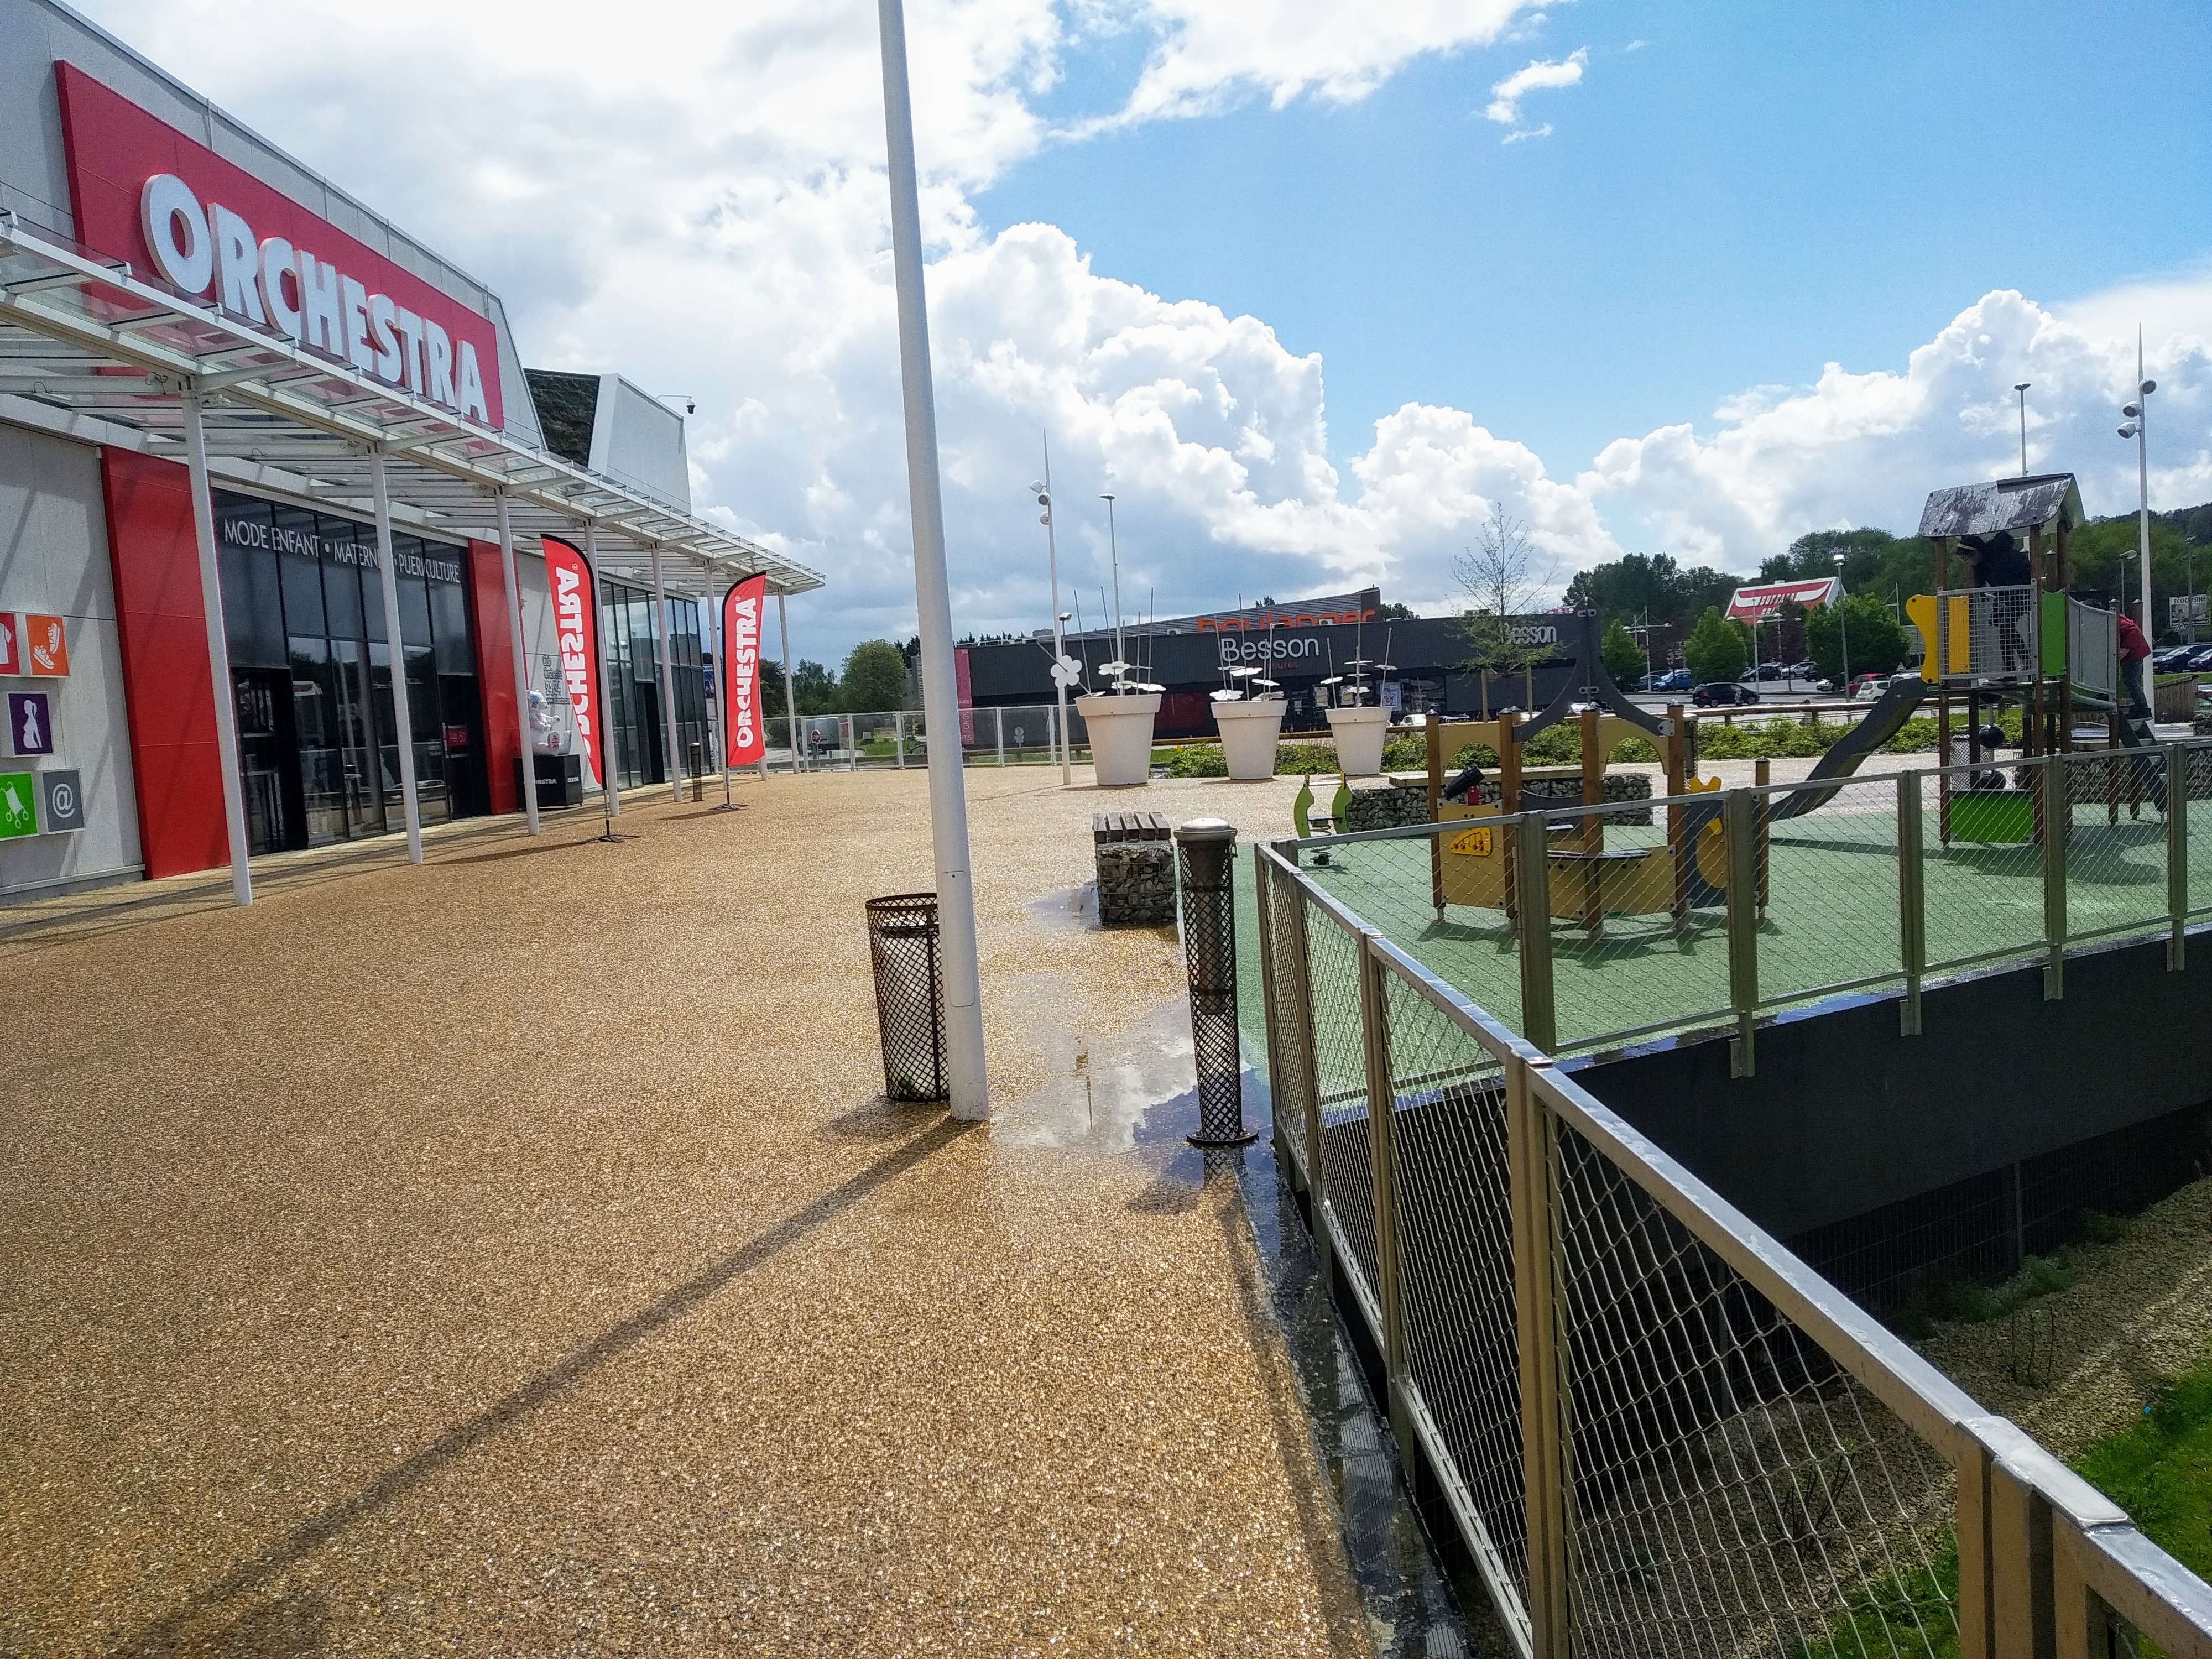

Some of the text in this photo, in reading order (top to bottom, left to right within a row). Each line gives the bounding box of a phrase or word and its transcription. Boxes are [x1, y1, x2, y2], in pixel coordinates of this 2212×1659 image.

[140, 173, 489, 424] ORCHESTRA
[225, 518, 460, 583] MODE ENFANT MATERN PUÉRICULTURE
[736, 597, 757, 748] ORCHESTRA
[1220, 637, 1320, 662] Besson
